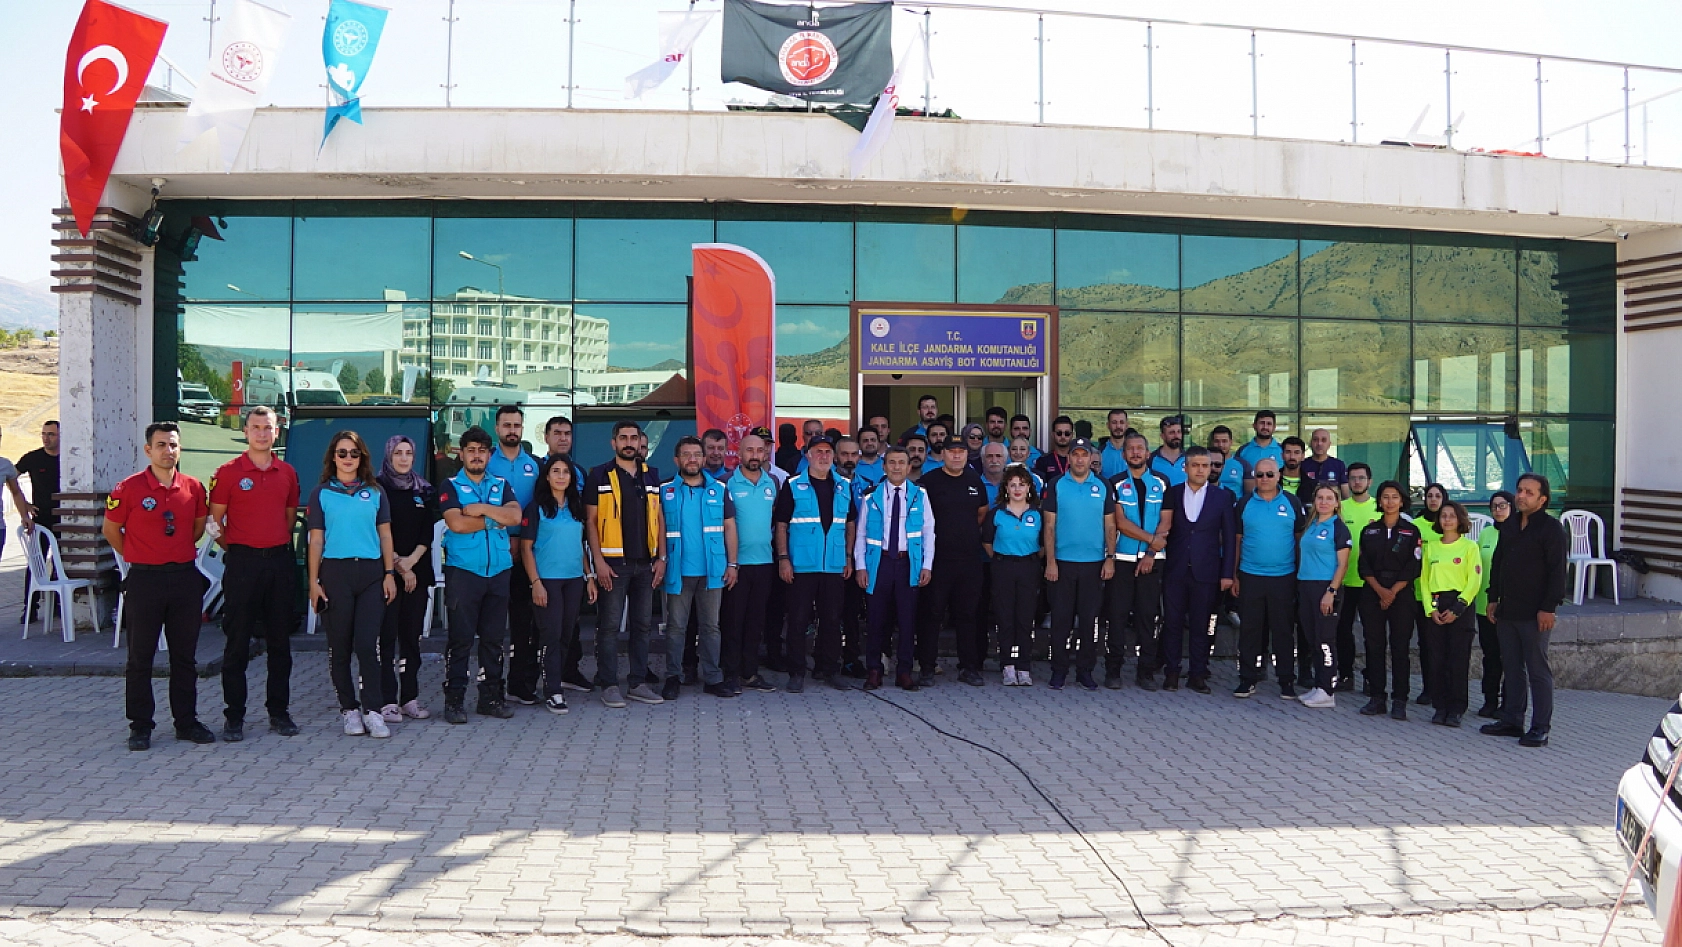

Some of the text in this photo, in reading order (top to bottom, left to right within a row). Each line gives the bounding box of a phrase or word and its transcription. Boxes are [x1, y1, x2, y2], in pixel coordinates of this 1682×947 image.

[945, 330, 963, 341] T.C.
[871, 340, 1037, 355] KALE İLÇE JANDARMA KOMUTANLIĞI
[868, 355, 1040, 369] JANDARMA ASAYİŞ BOT KOMUTANLIĞI
